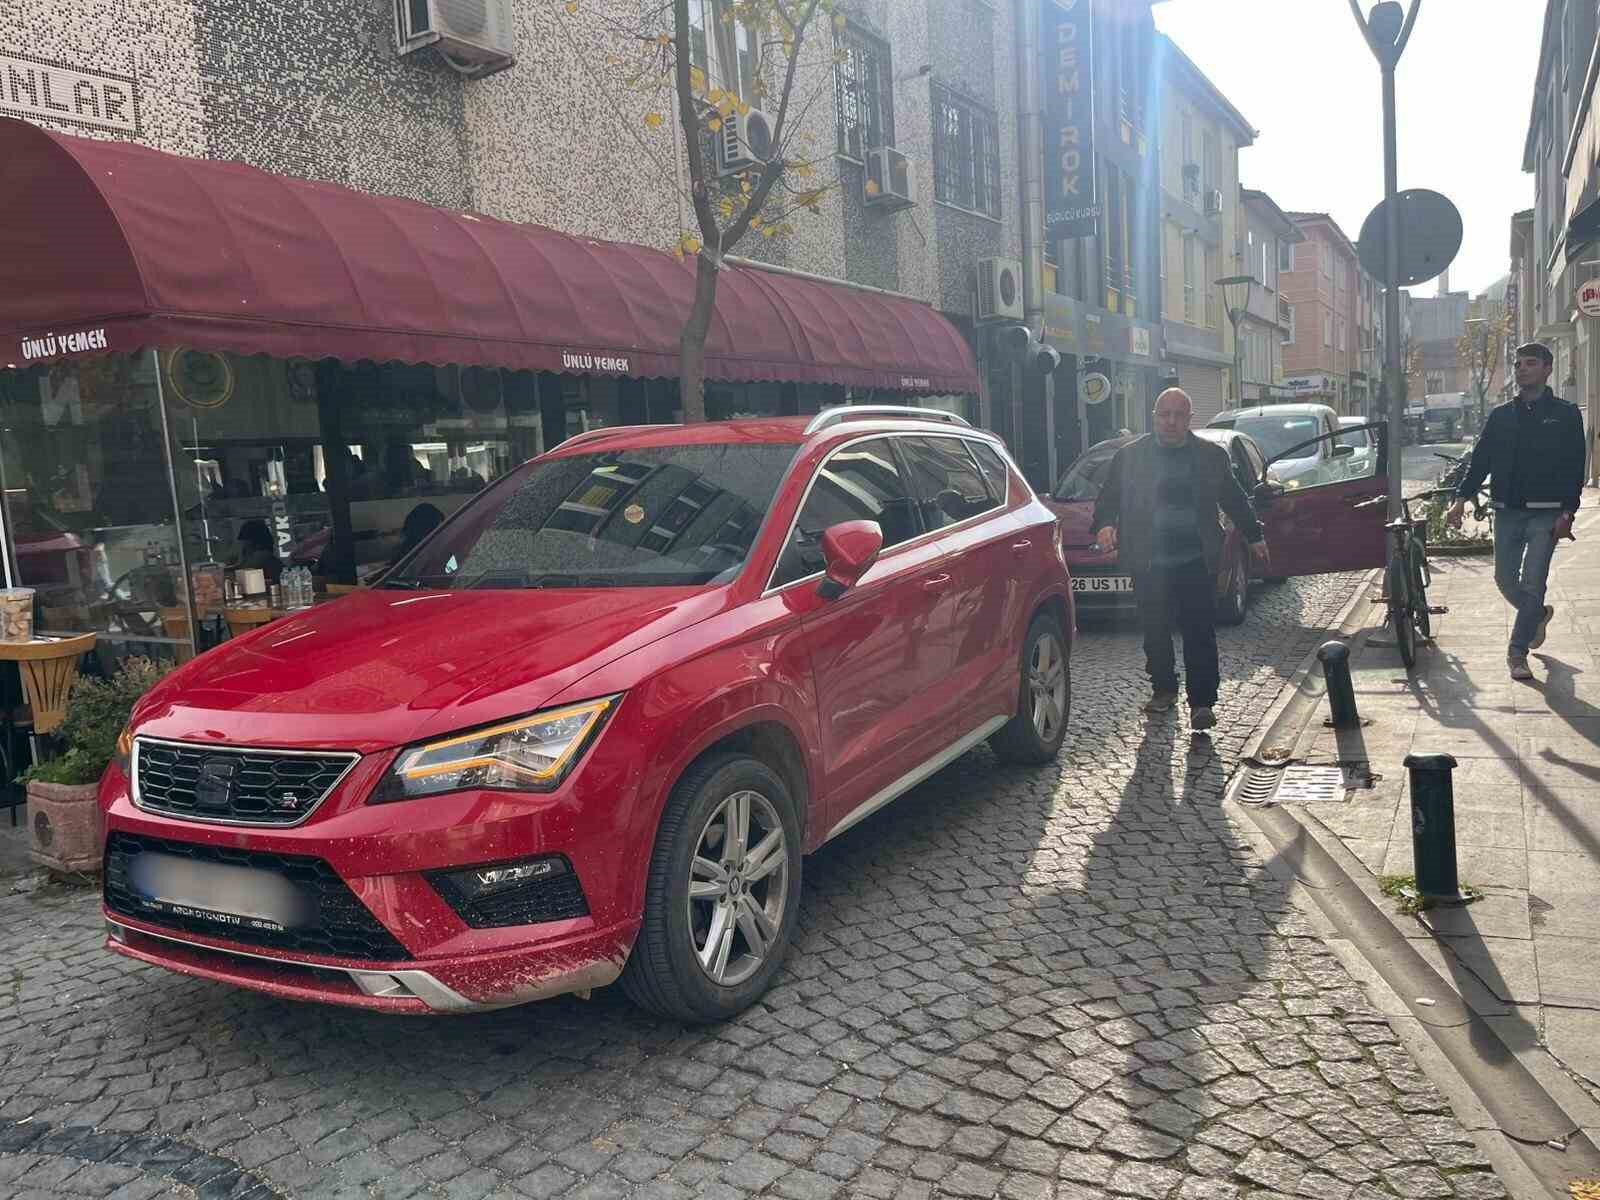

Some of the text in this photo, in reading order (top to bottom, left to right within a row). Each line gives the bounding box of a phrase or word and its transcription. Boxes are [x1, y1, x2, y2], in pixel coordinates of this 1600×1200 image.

[21, 329, 108, 360] ÜNLÜ YEMEK
[562, 350, 630, 372] ÜNLÜ YEMEK
[1072, 579, 1086, 591] 26
[1092, 579, 1110, 591] US
